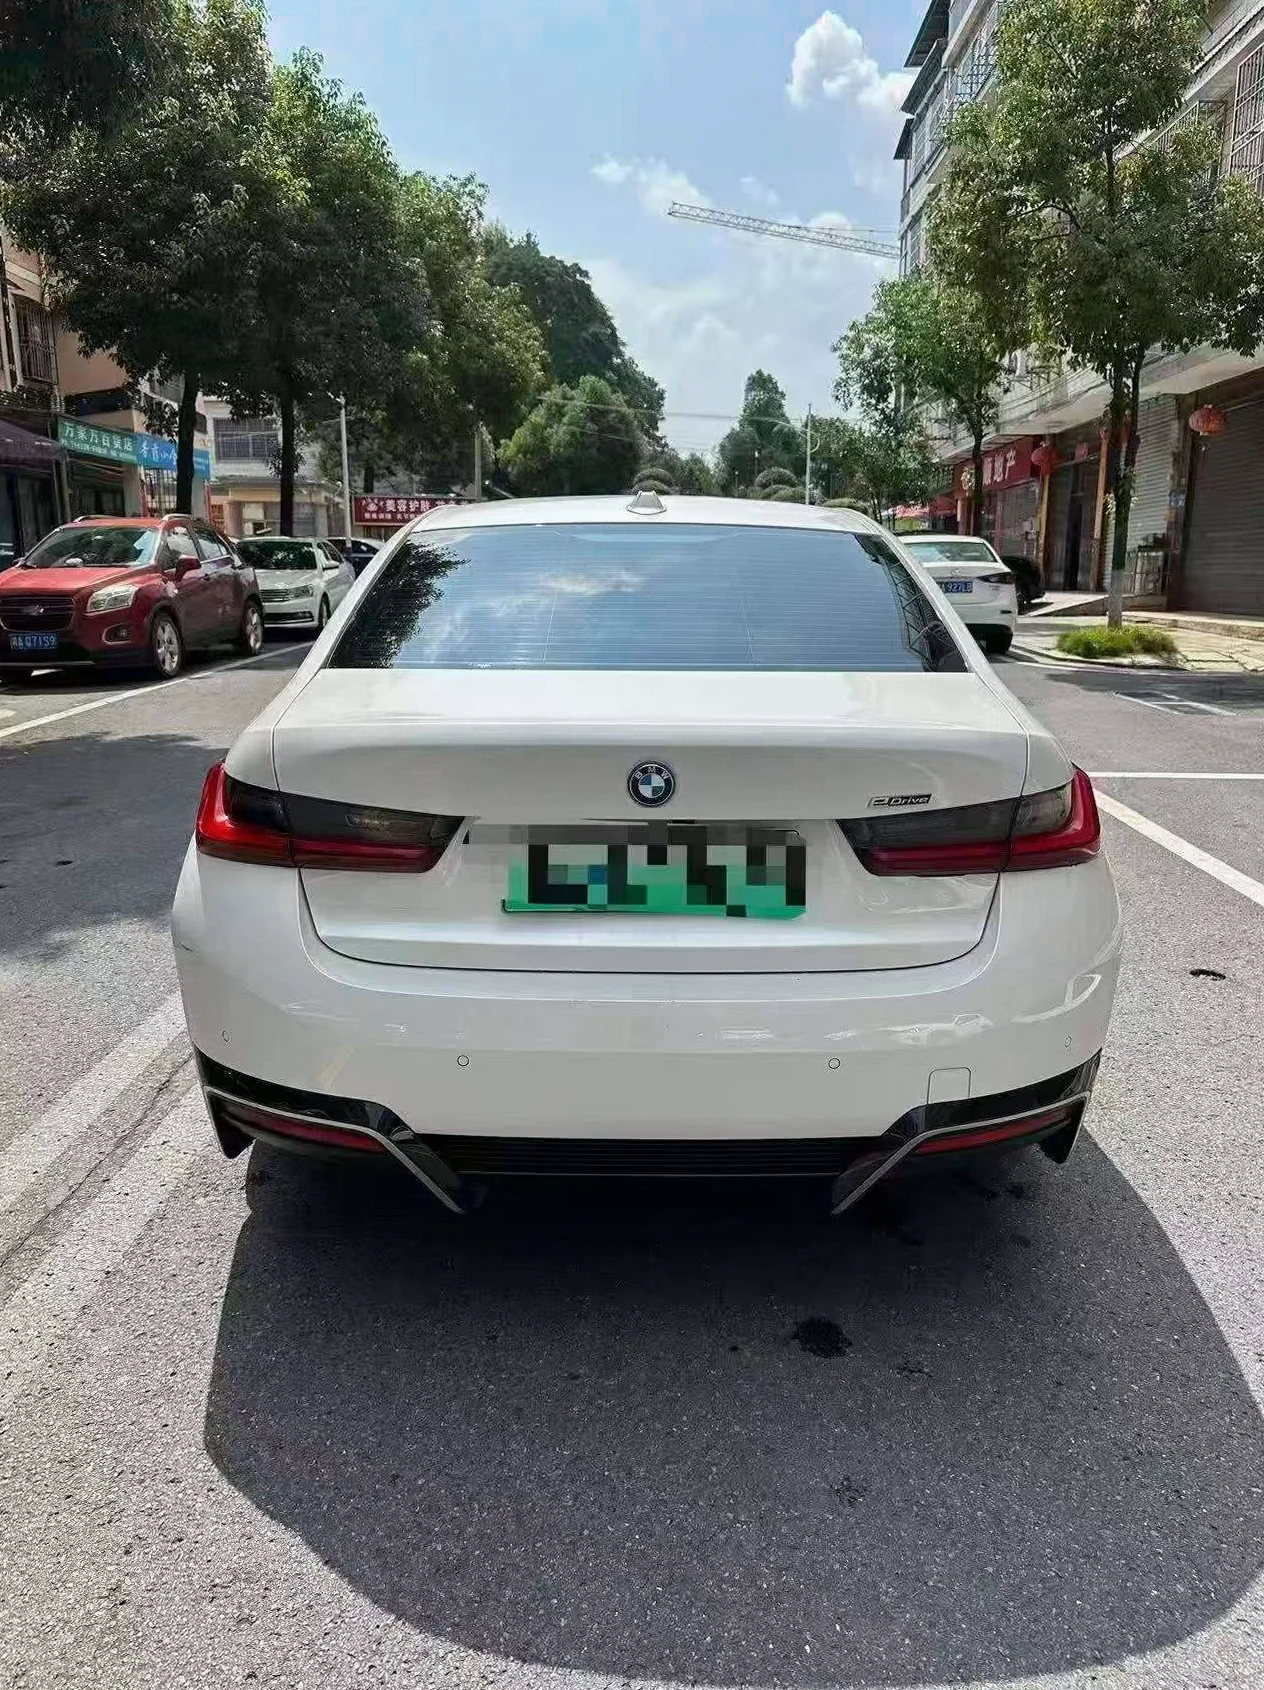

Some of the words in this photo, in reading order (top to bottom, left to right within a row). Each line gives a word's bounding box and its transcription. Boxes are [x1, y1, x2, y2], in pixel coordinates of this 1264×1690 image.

[385, 498, 431, 513] 美容护肤
[634, 766, 670, 780] BMW
